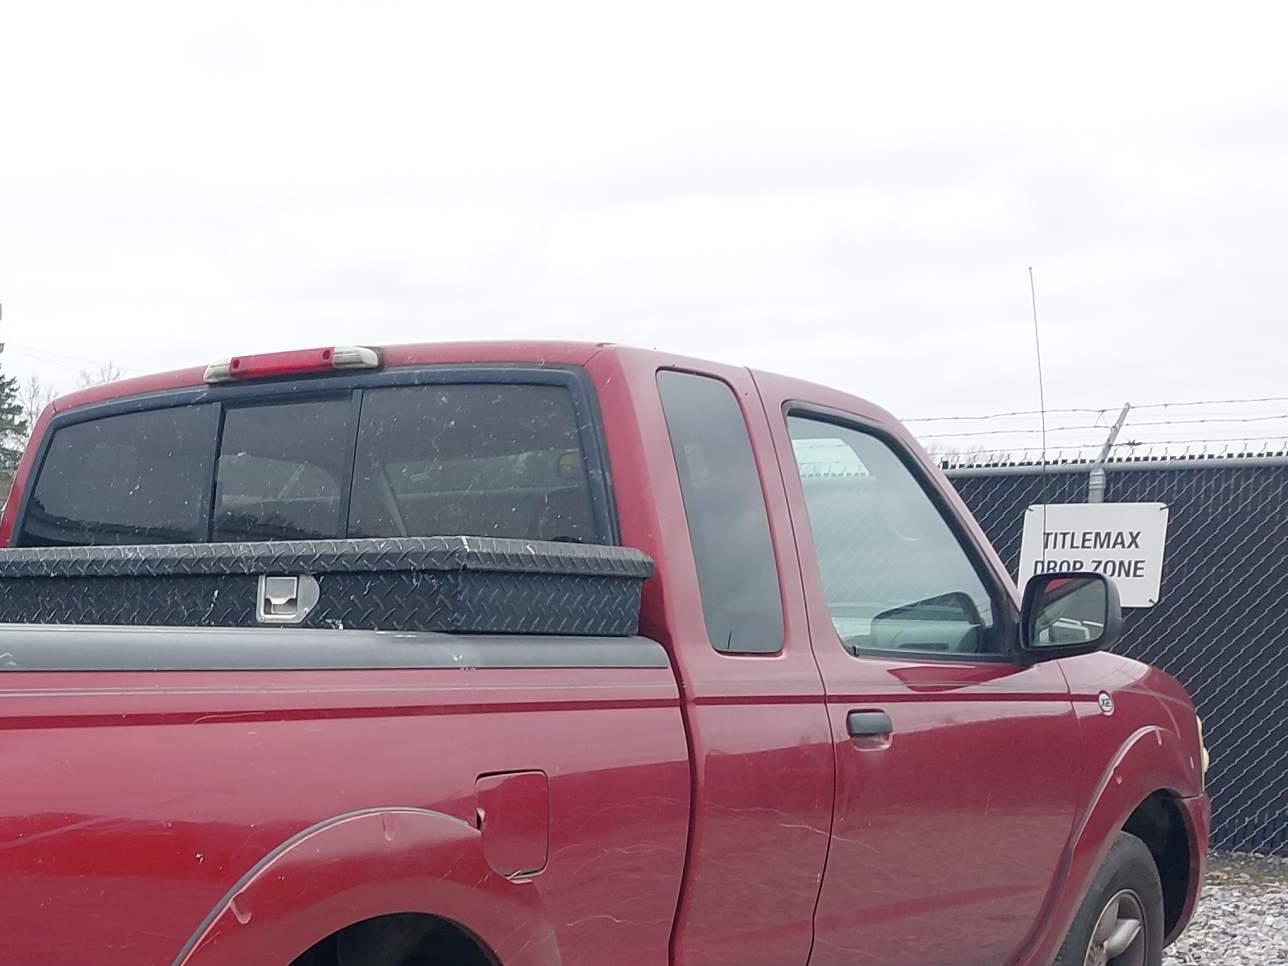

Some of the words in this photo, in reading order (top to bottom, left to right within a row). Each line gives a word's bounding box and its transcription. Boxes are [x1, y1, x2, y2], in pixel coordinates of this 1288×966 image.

[1043, 531, 1141, 550] TITLEMAX
[1033, 560, 1084, 574] DROP
[1091, 560, 1145, 577] ZONE
